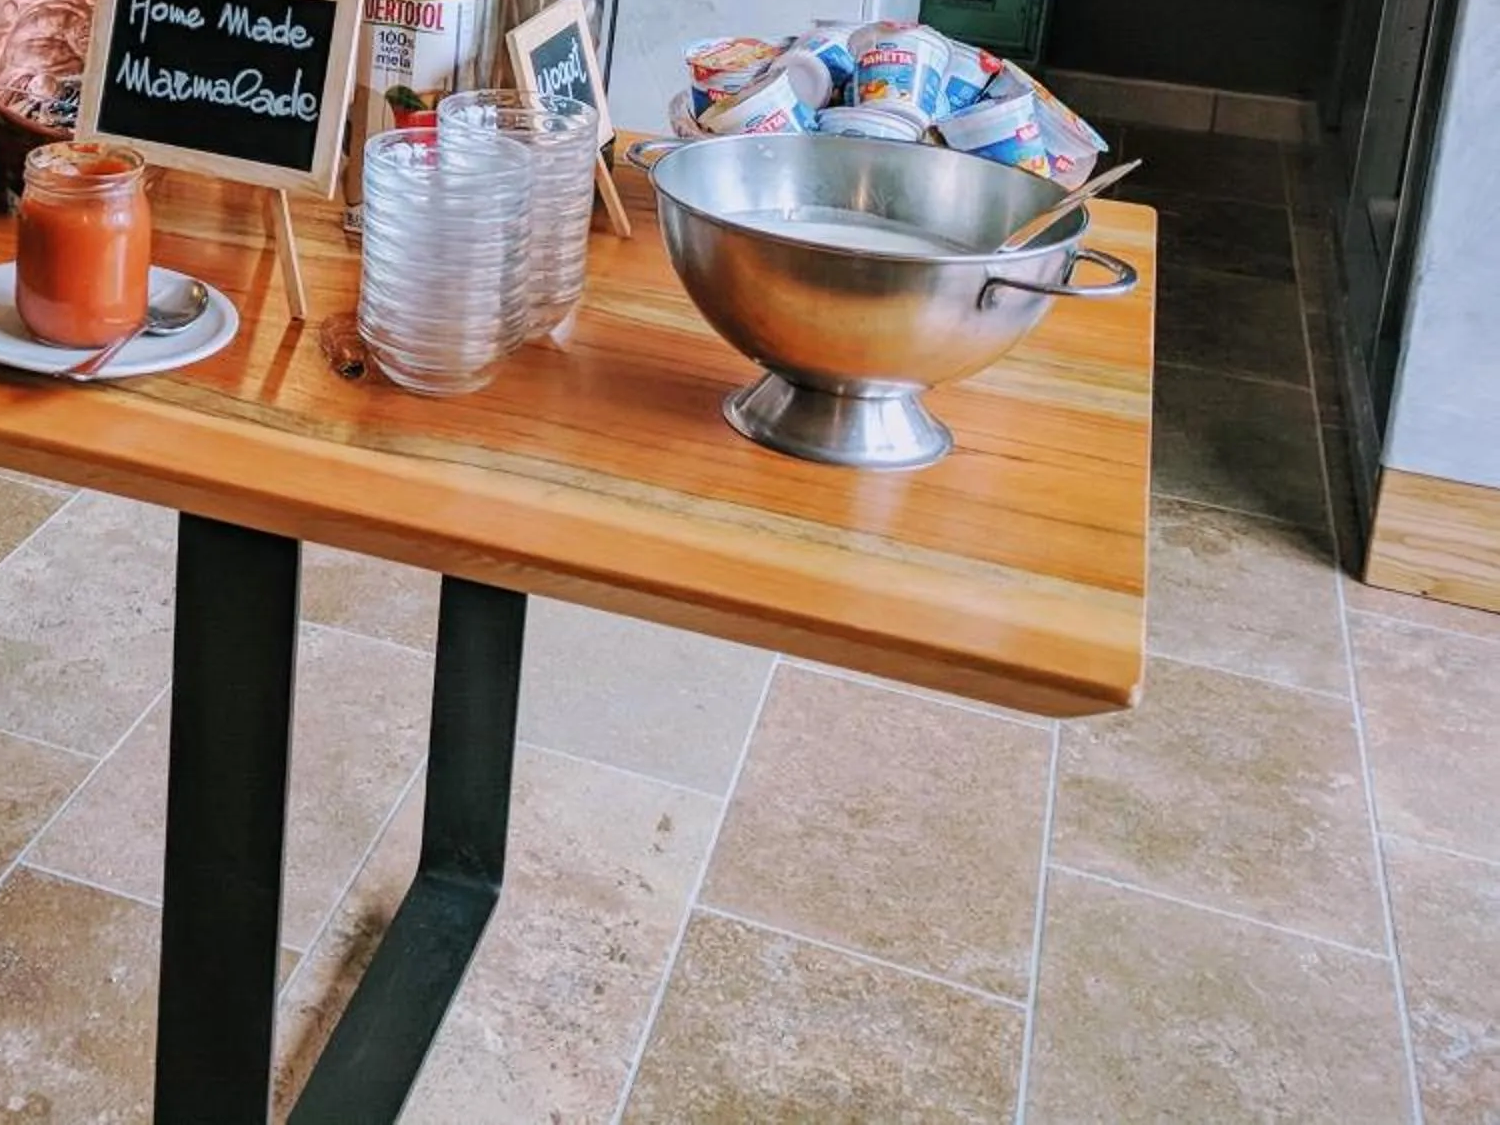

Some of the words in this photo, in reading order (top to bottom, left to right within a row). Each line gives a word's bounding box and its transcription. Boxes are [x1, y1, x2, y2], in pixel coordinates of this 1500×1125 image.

[217, 2, 315, 49] Made
[375, 54, 411, 68] mela
[116, 52, 319, 122] Marmalade
